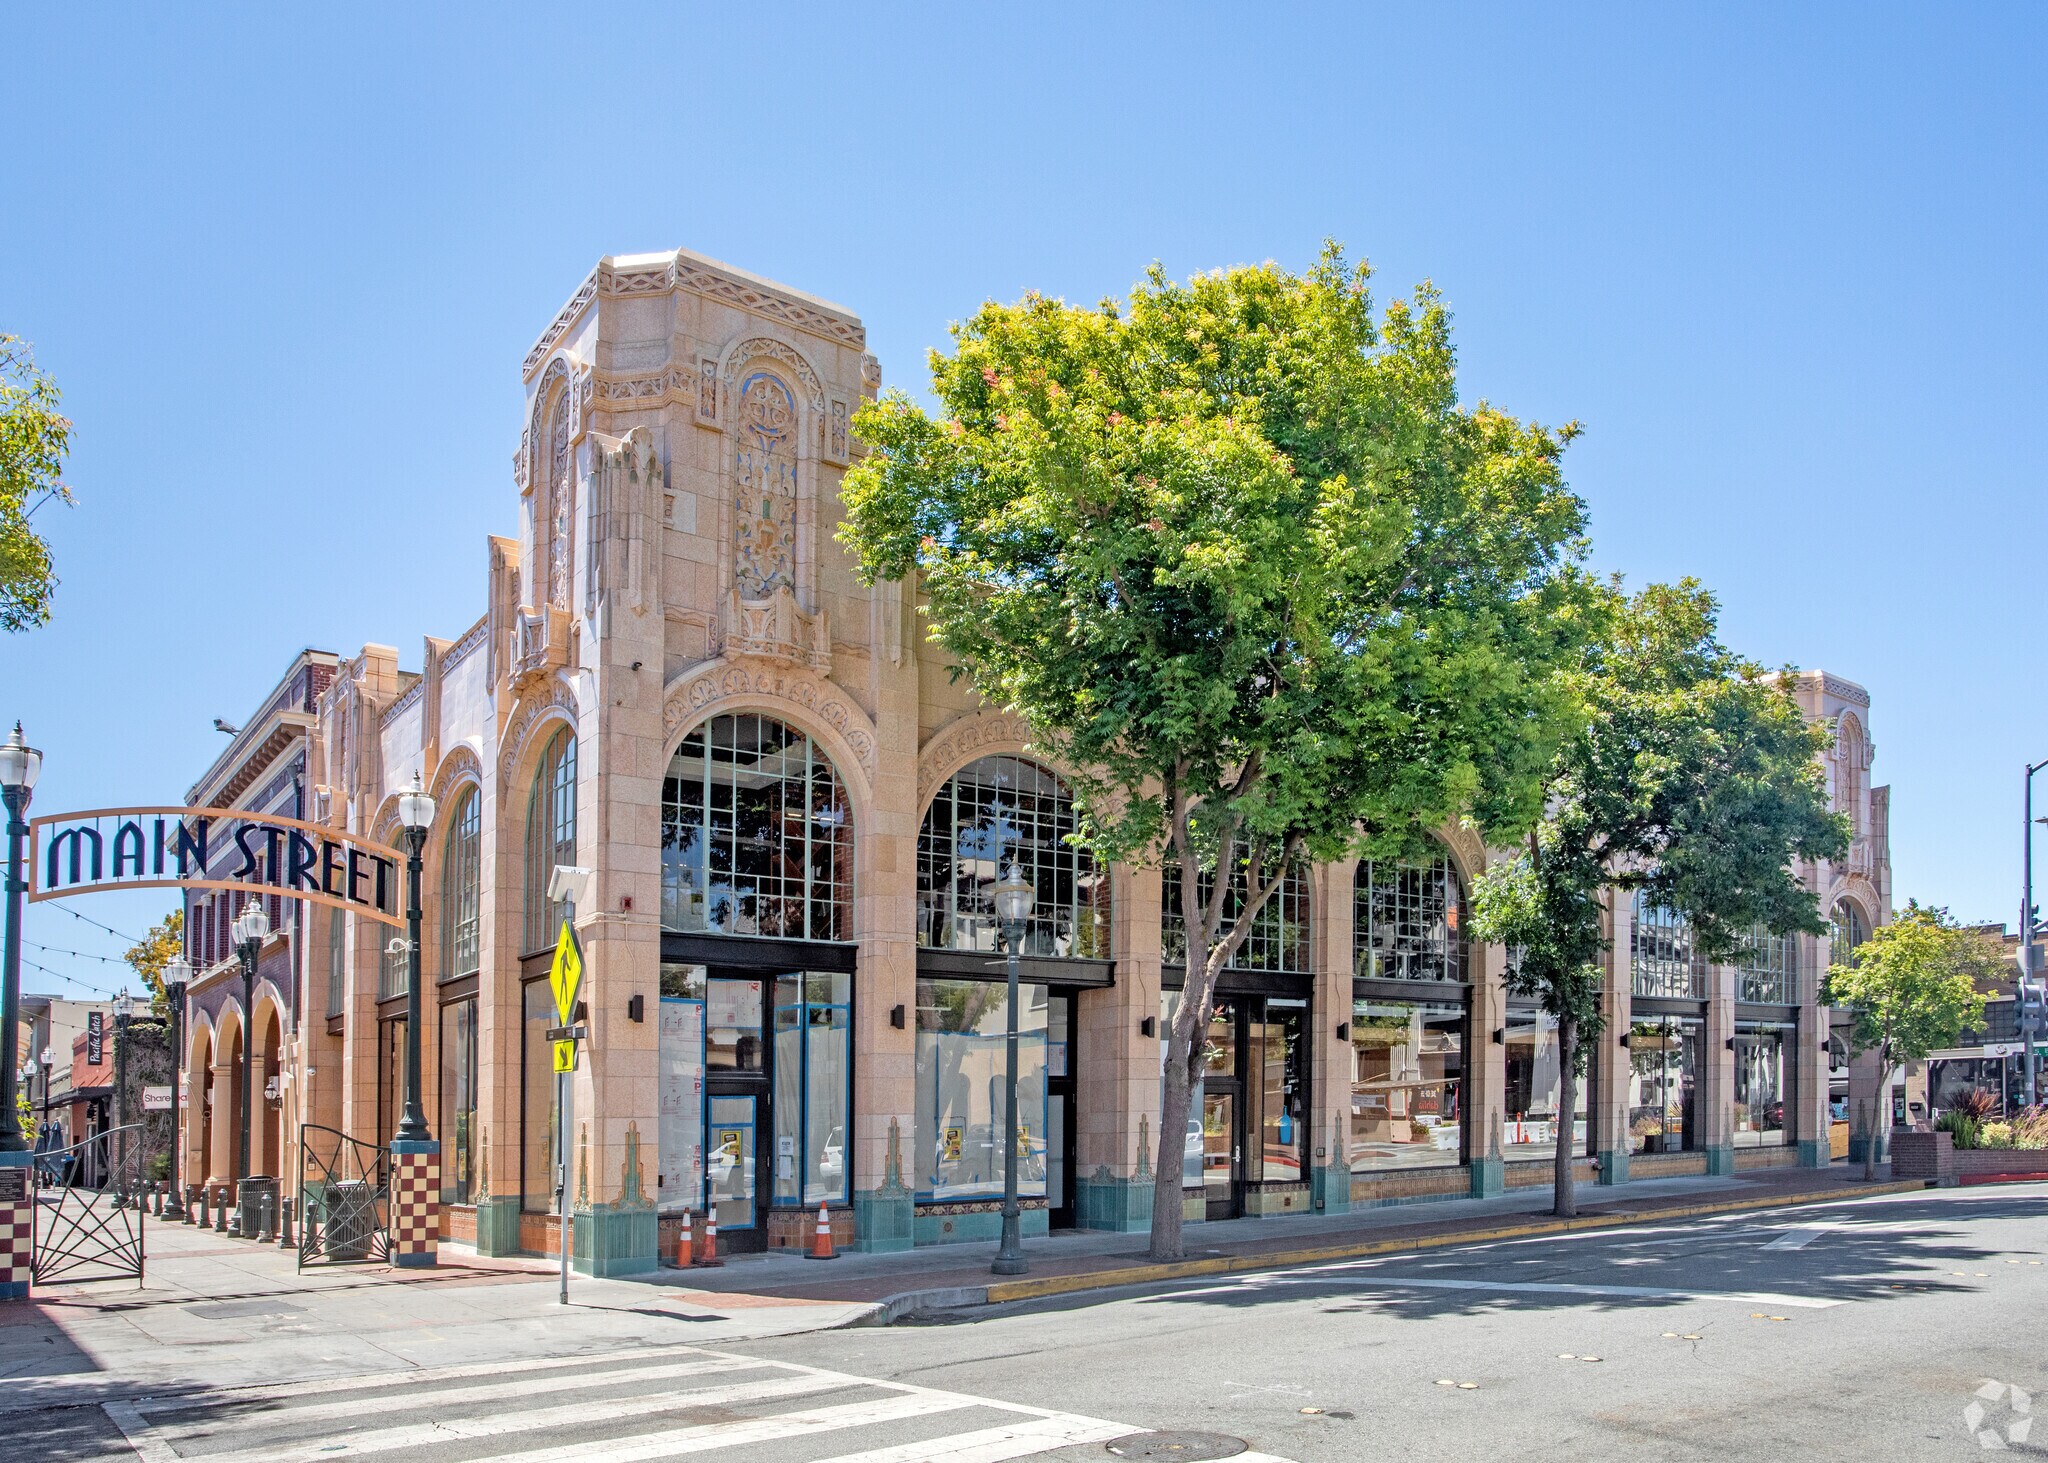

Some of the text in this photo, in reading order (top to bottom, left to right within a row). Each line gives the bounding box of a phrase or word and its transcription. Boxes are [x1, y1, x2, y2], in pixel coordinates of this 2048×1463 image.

[47, 819, 394, 911] MAIN STREET
[90, 1014, 101, 1062] Pacific Catch
